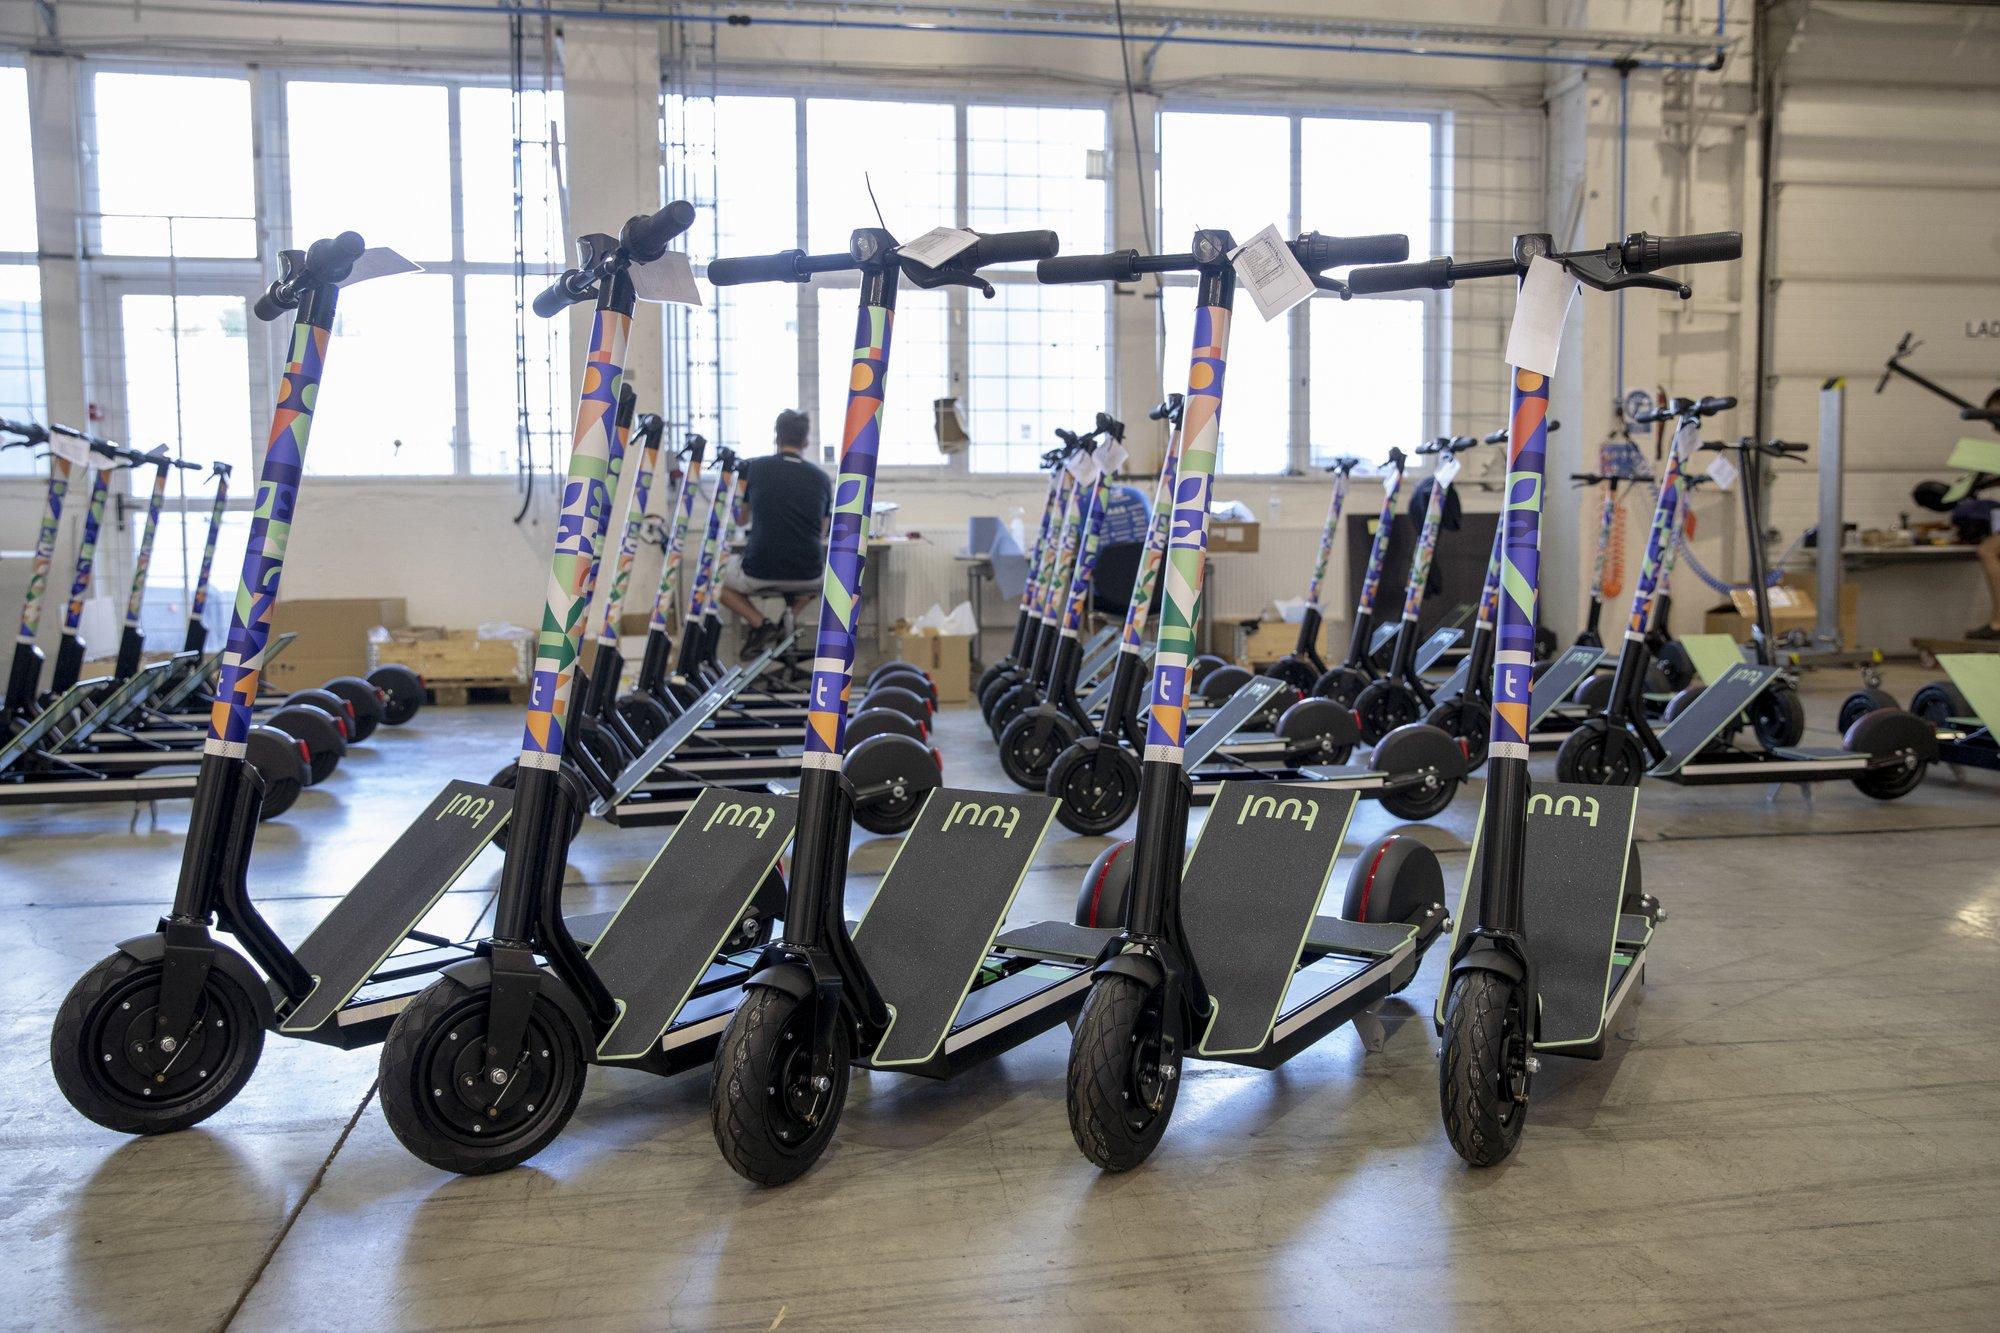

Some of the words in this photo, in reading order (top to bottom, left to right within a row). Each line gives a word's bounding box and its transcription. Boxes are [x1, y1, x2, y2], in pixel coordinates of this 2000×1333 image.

[532, 677, 542, 706] t
[816, 677, 828, 708] t
[1160, 671, 1172, 701] t
[1504, 669, 1517, 699] t
[435, 792, 496, 830] tuul
[702, 801, 776, 840] tuul
[940, 801, 1021, 839] tuul
[1236, 794, 1319, 832] tuul
[1526, 793, 1600, 828] tuu
